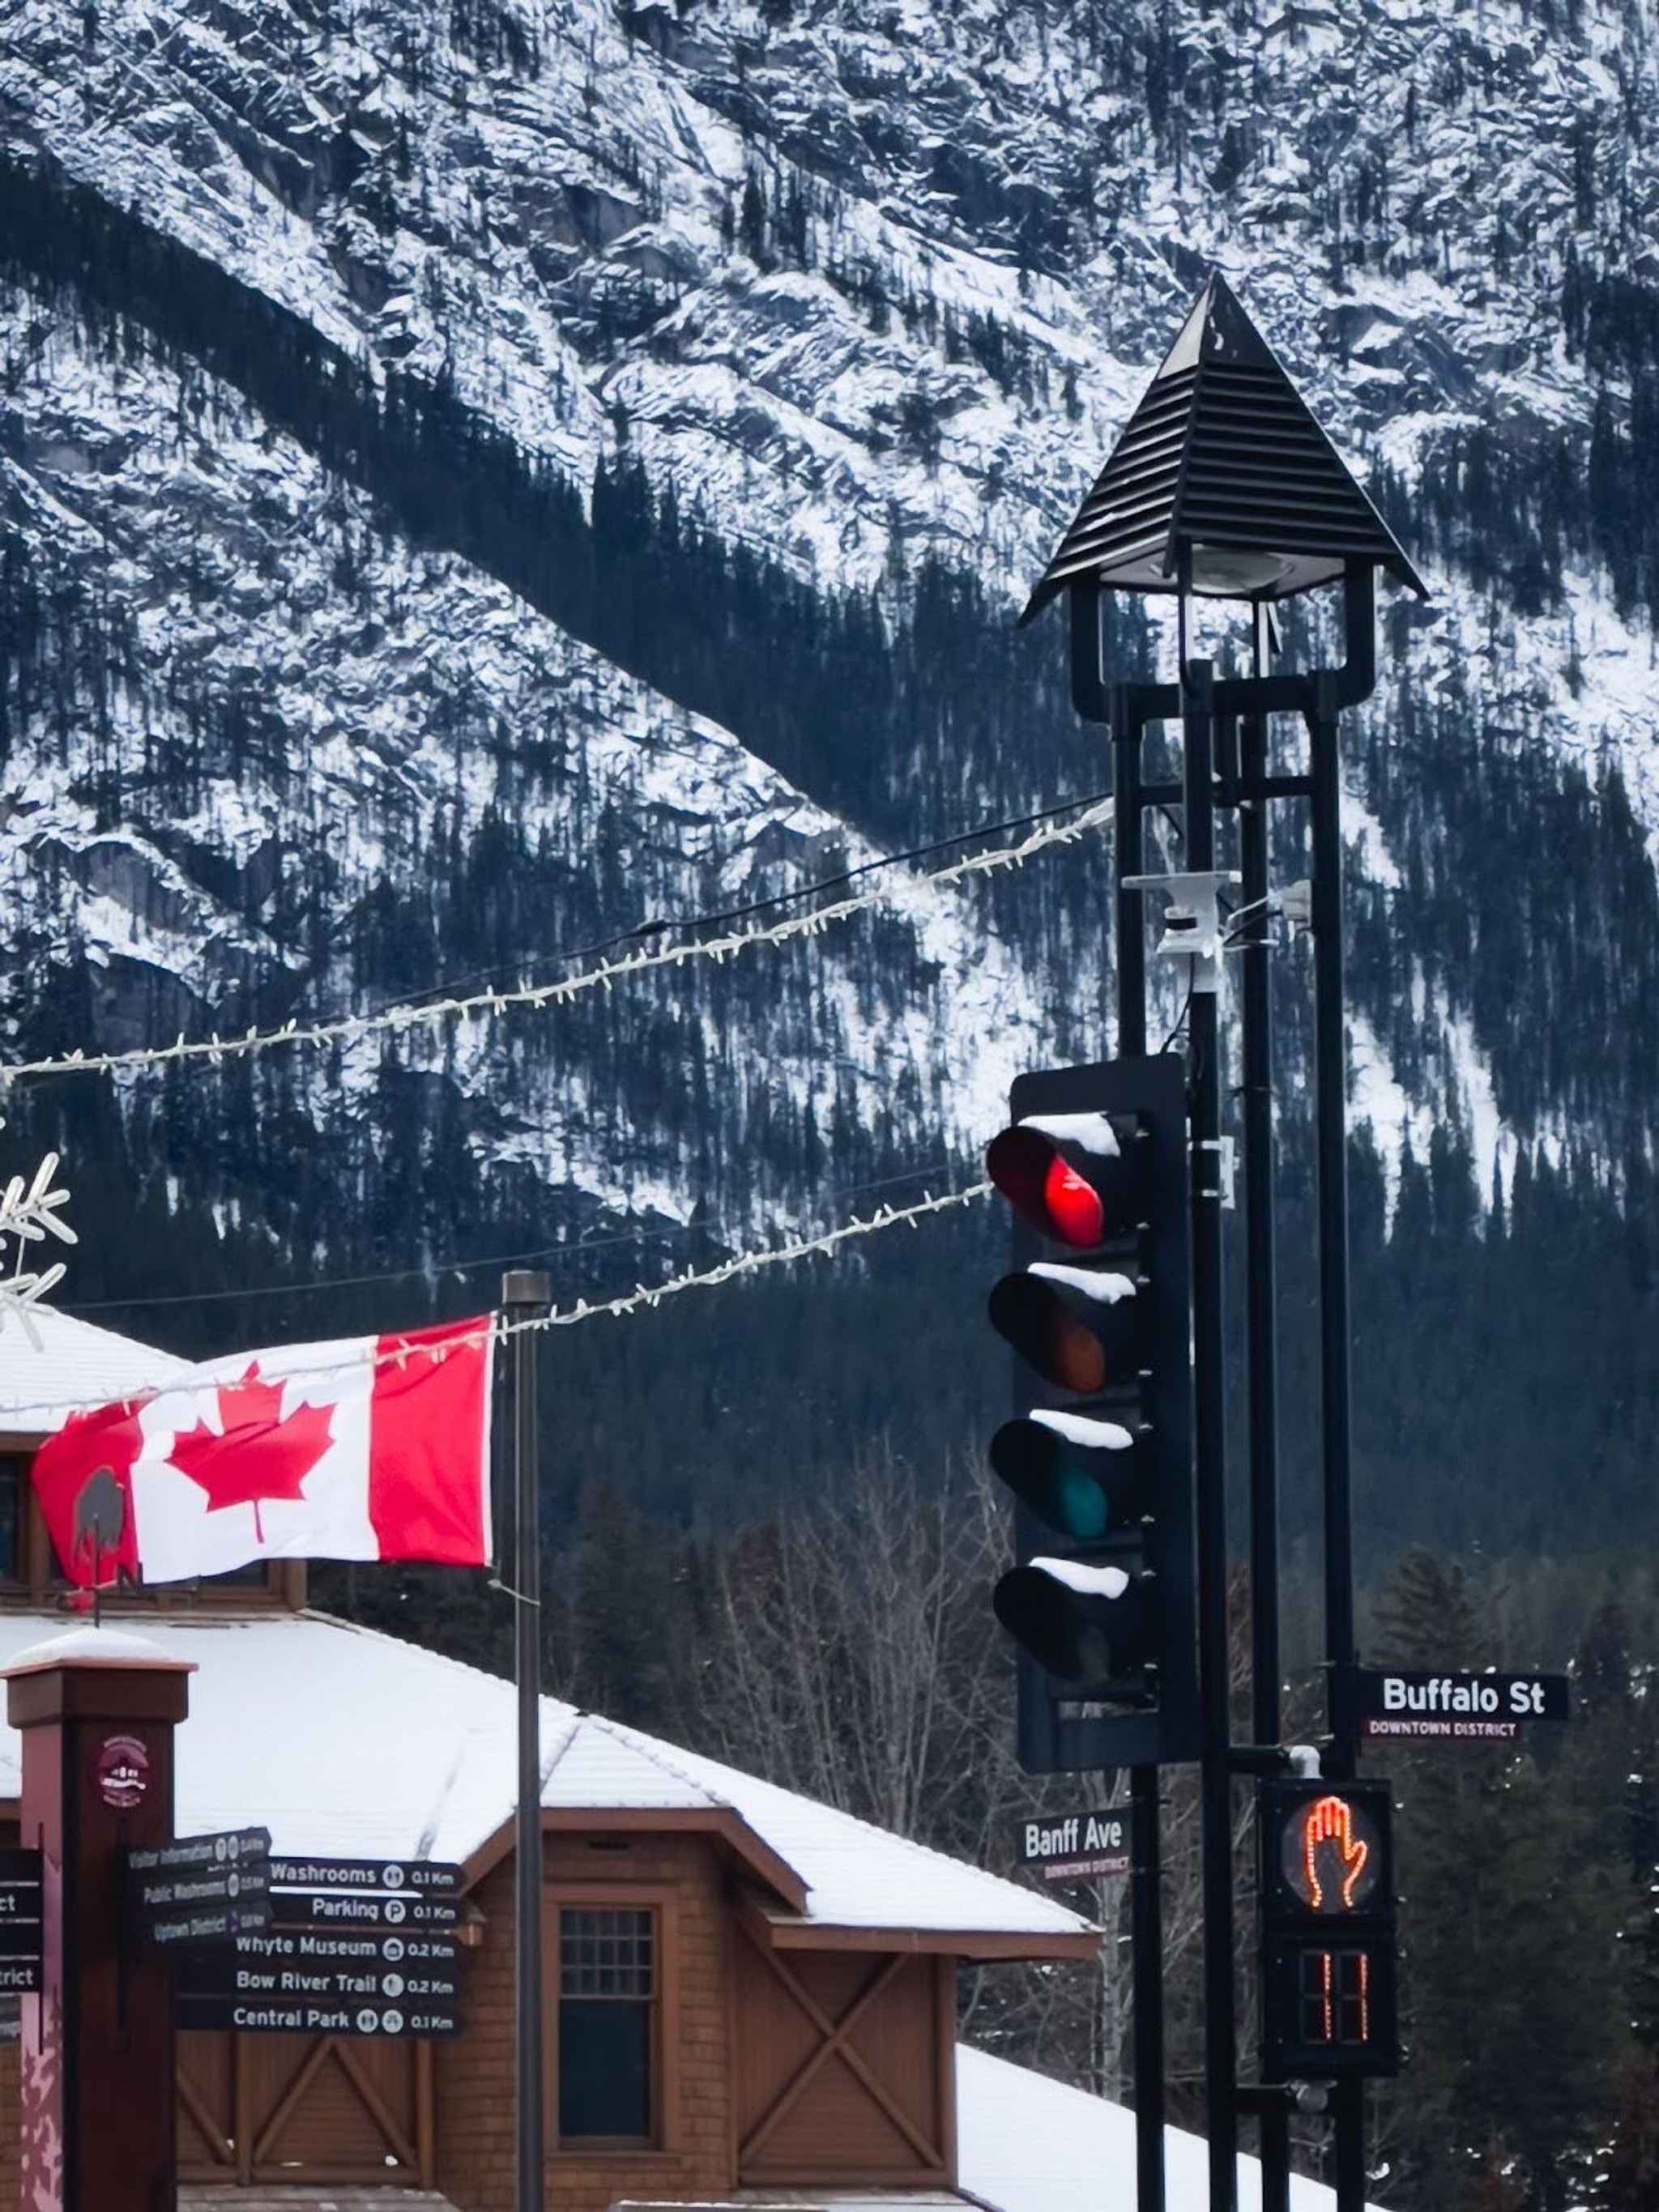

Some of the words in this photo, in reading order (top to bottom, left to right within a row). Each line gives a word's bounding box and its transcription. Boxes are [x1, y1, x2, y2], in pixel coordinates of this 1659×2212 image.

[1384, 1678, 1499, 1713] Buffalo
[1509, 1681, 1545, 1714] St
[1370, 1721, 1451, 1735] DOWNTOWN
[1454, 1723, 1516, 1737] DISTRICT
[1026, 1818, 1079, 1857] Banff
[1084, 1816, 1122, 1852] Ave
[271, 1863, 377, 1883] Washrooms
[412, 1872, 429, 1884] 0.1
[432, 1873, 454, 1885] Km
[313, 1897, 379, 1920] Parking
[414, 1906, 431, 1919] 0.1
[433, 1907, 455, 1920] Km
[237, 1936, 294, 1956] Whyte
[300, 1937, 377, 1955] Museum
[408, 1944, 429, 1956] 0.2
[432, 1945, 454, 1957] Km
[237, 1971, 276, 1988] Bow
[282, 1972, 331, 1990] River
[336, 1974, 377, 1992] Trail
[407, 1981, 429, 1993] 0.2
[431, 1981, 454, 1993] Km
[1323, 1953, 1368, 2041] 11
[233, 2008, 301, 2027] Central
[308, 2010, 349, 2027] Park
[412, 2016, 430, 2028] 0.1
[432, 2016, 454, 2029] Km
